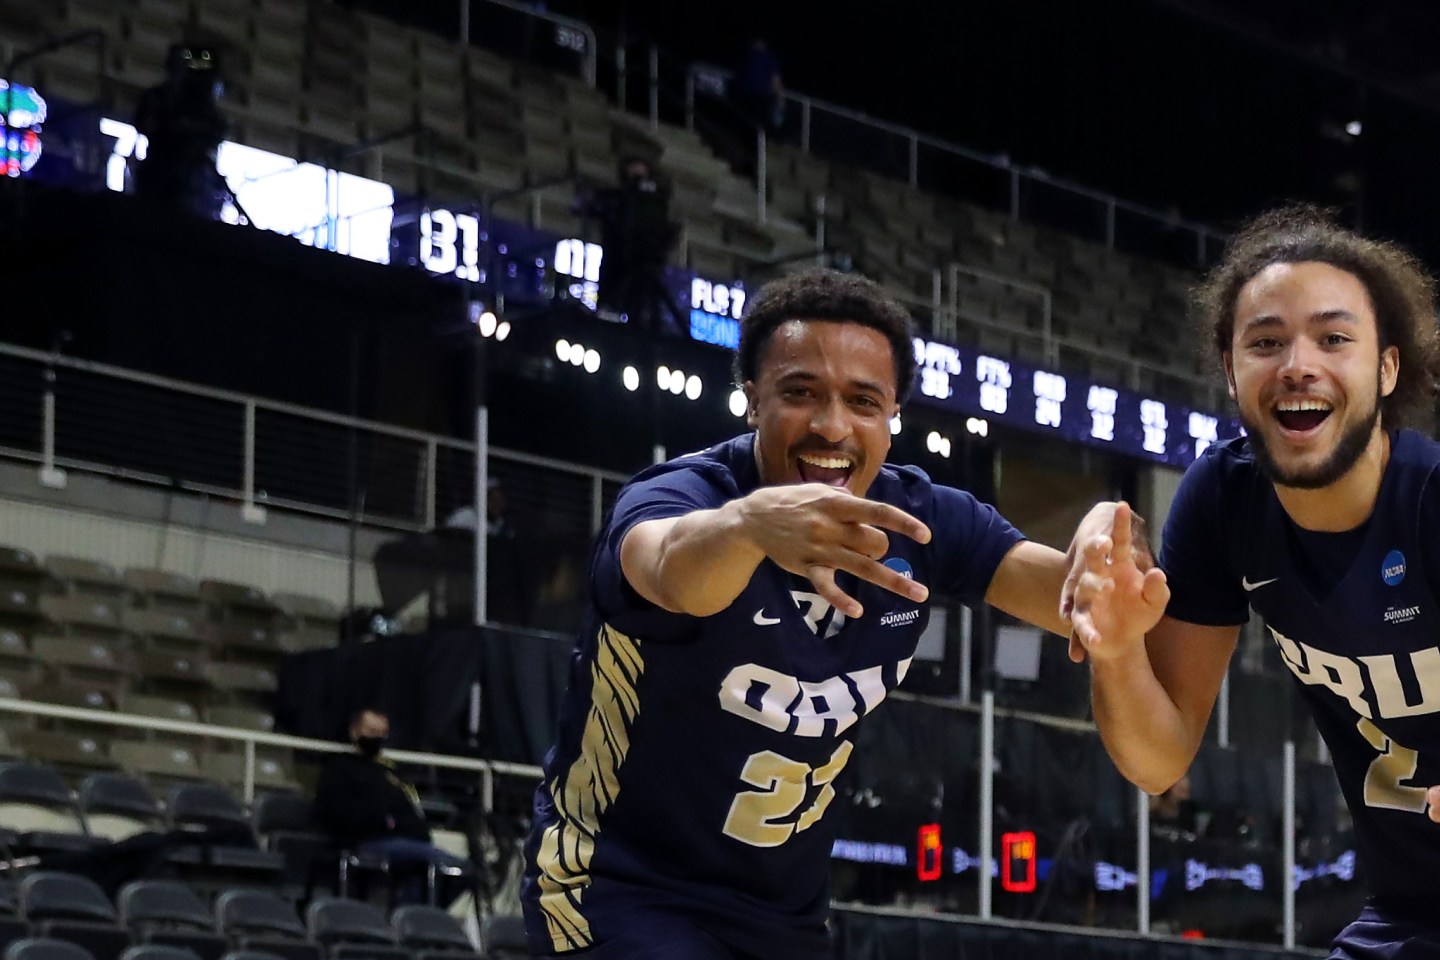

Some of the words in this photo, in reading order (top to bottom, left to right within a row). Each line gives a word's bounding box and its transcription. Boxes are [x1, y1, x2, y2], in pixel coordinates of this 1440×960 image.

[880, 609, 919, 626] SUMMIT
[1384, 606, 1420, 621] SUMMIT
[1356, 716, 1428, 814] 2
